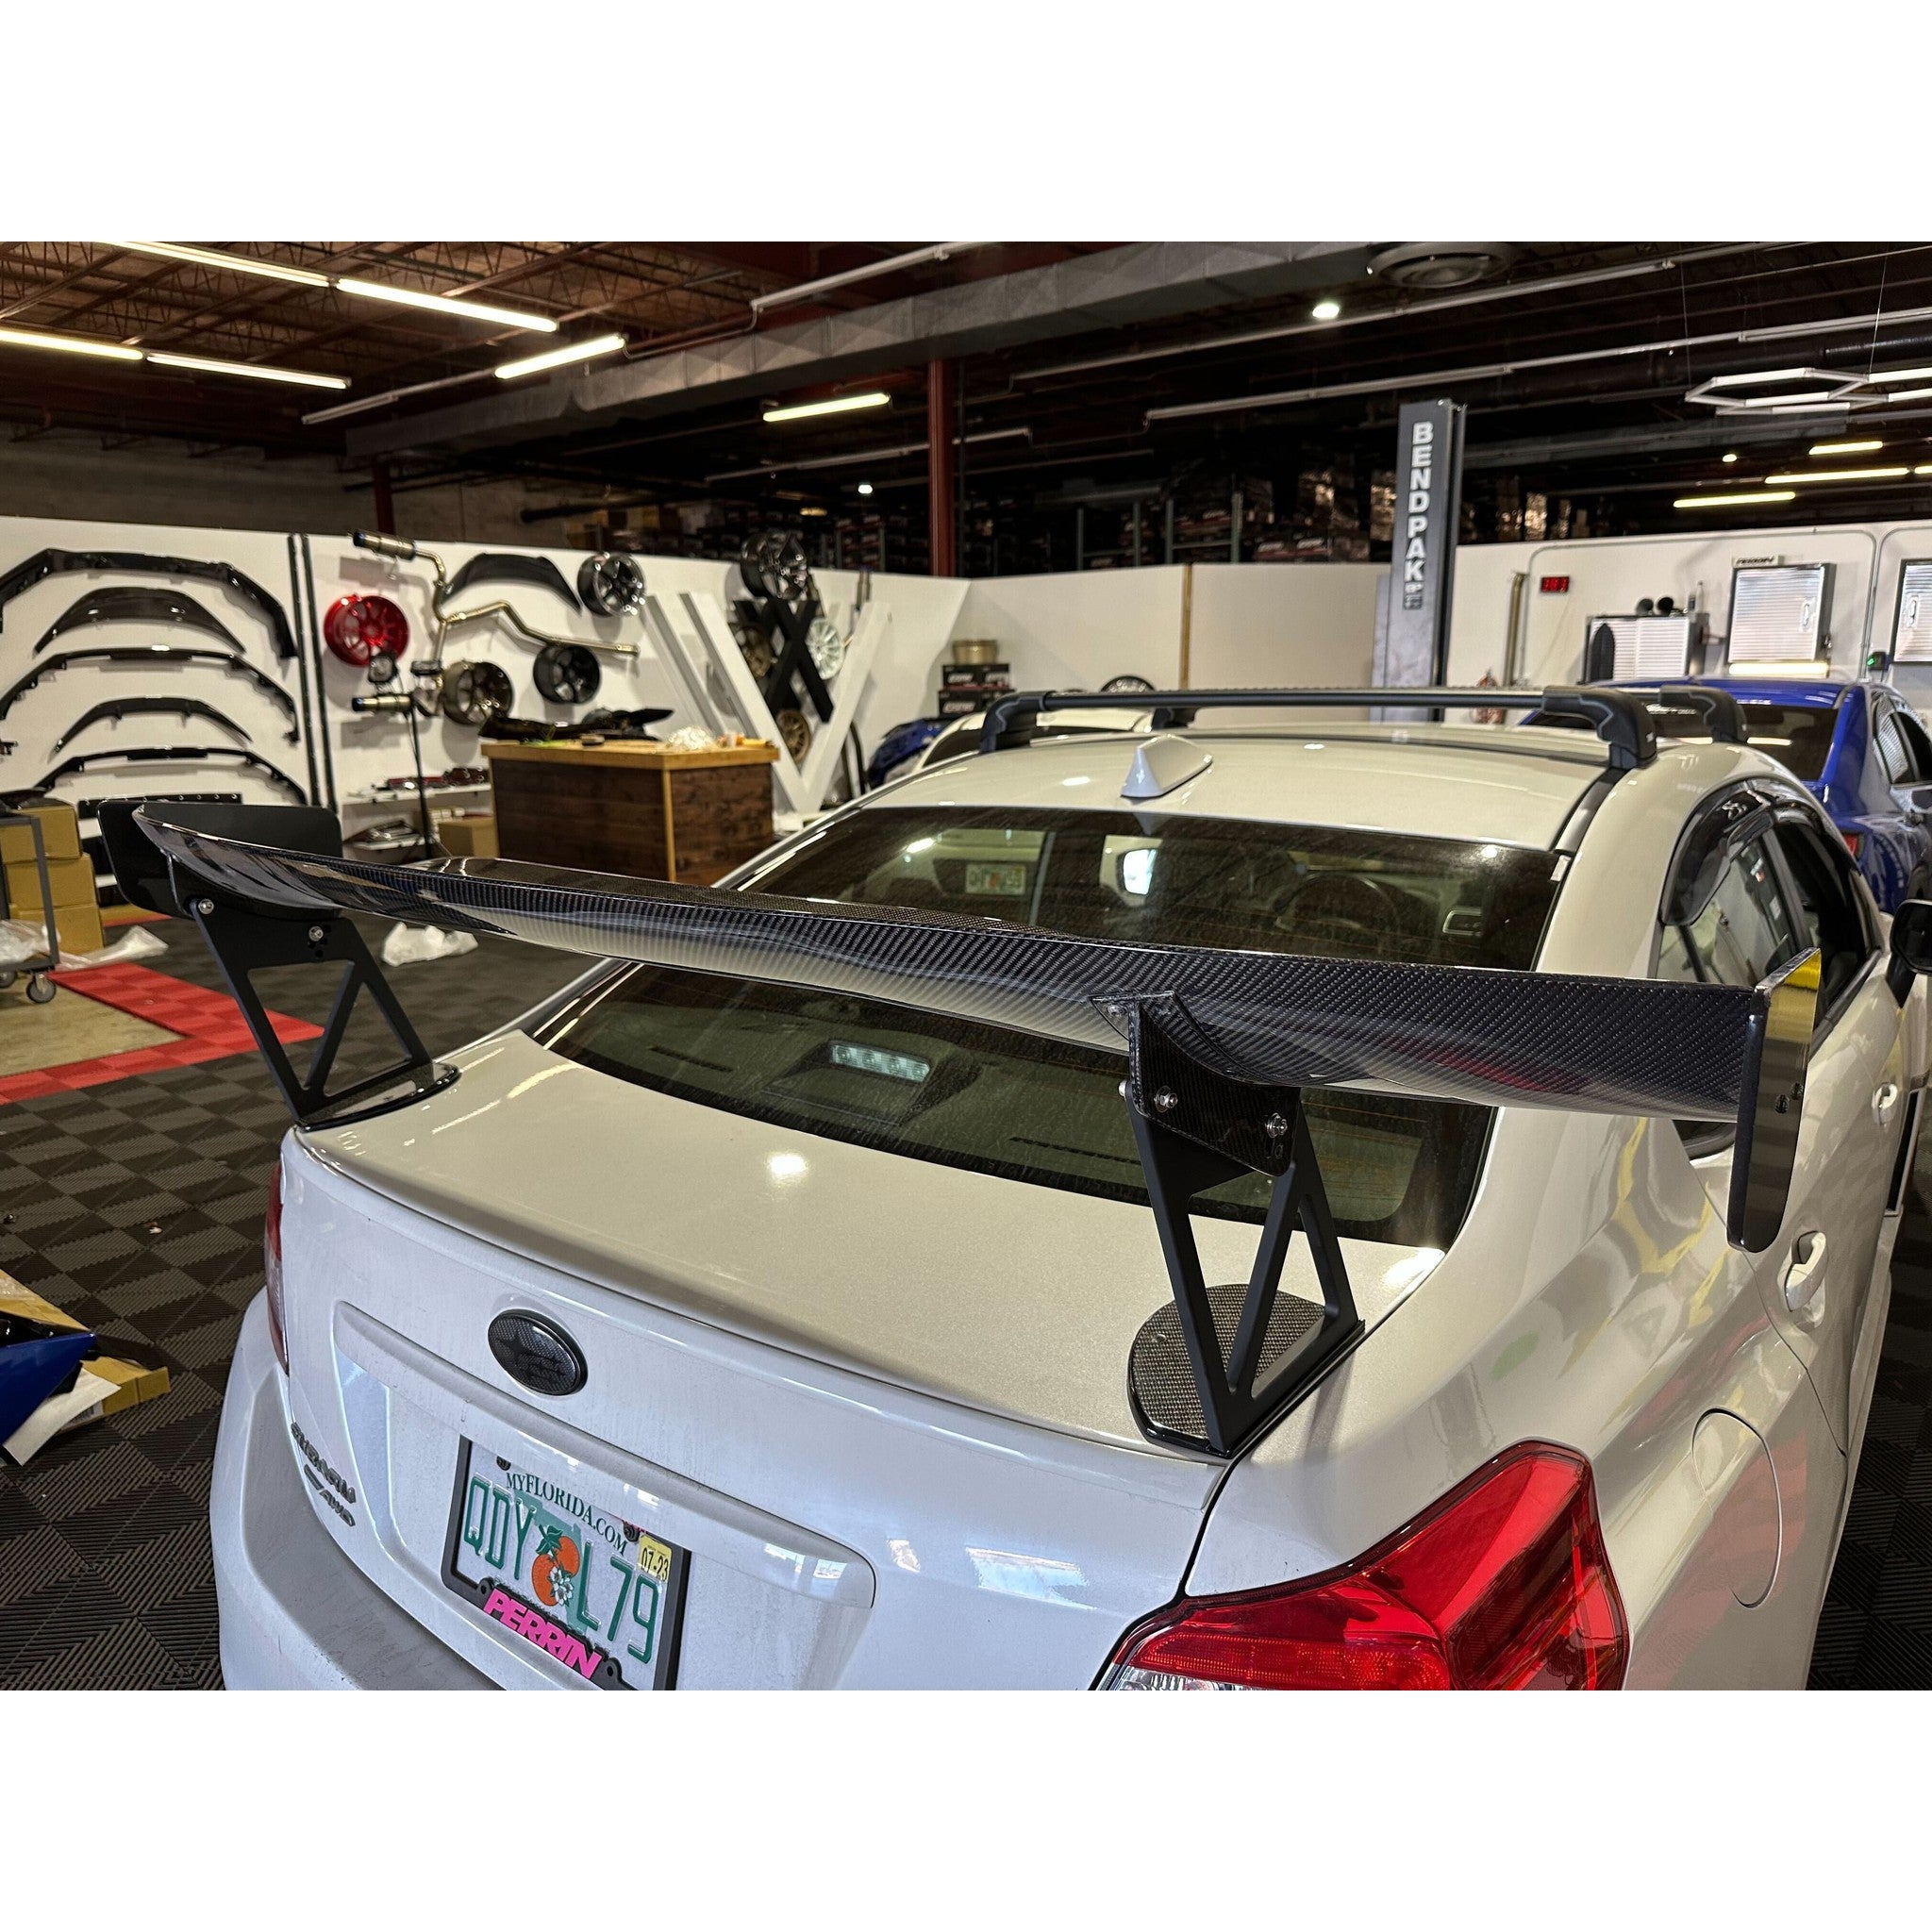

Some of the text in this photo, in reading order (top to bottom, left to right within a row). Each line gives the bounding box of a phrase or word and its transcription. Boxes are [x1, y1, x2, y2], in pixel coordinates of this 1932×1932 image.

[1404, 422, 1434, 582] BENDPAK
[319, 1490, 356, 1527] AWD
[506, 1472, 627, 1557] MYFLORIDA.COM
[463, 1473, 659, 1664] QDY L79
[483, 1588, 603, 1680] PERRIN
